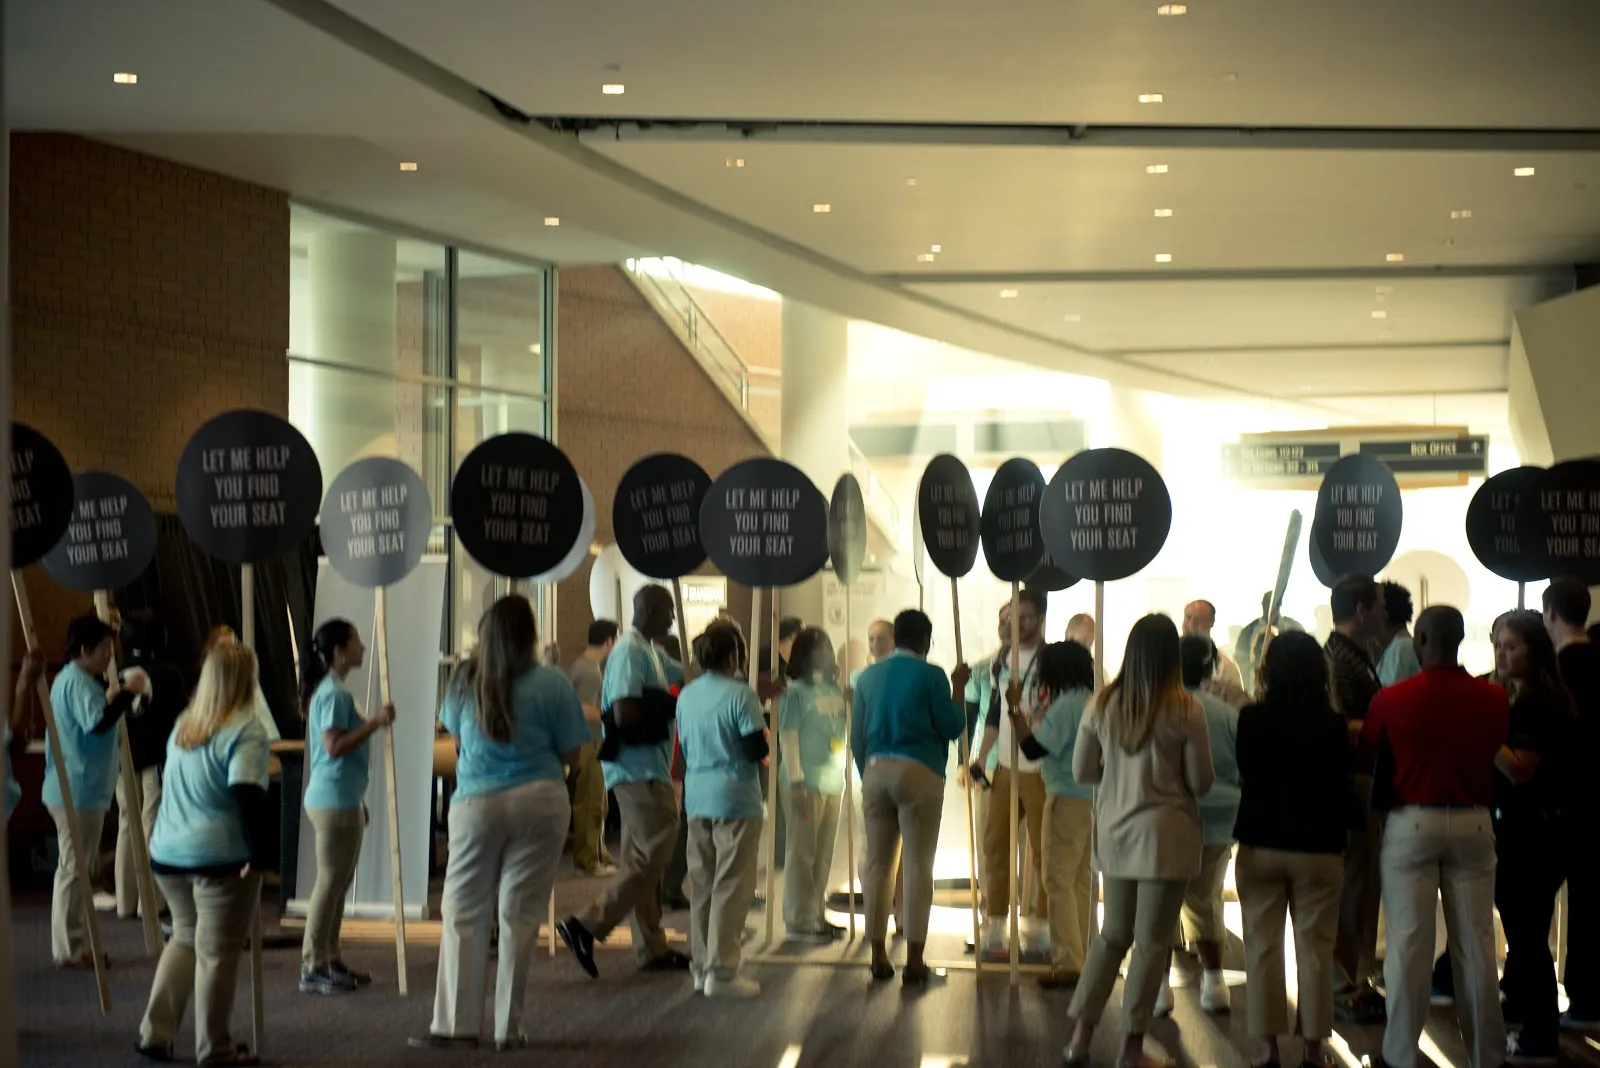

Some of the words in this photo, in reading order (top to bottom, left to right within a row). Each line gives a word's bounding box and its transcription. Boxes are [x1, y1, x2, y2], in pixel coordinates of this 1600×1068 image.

[202, 448, 225, 472] LET
[230, 447, 250, 471] ME
[256, 445, 290, 470] HELP
[214, 475, 242, 500] YOU
[248, 473, 279, 499] FIND
[481, 463, 502, 488] LET
[508, 467, 525, 490] ME
[530, 468, 560, 493] HELP
[1065, 480, 1084, 502] LET
[1090, 479, 1107, 501] ME
[1112, 478, 1142, 500] HELP
[79, 499, 96, 520] ME
[100, 494, 127, 516] HELP
[340, 490, 357, 513] LET
[362, 487, 377, 510] ME
[381, 484, 407, 507] HELP
[490, 492, 516, 516] YOU
[520, 494, 547, 519] FIND
[630, 487, 647, 512] LET
[651, 484, 667, 504] ME
[671, 479, 695, 502] HELP
[726, 488, 745, 509] LET
[750, 488, 767, 509] ME
[772, 488, 800, 510] HELP
[1331, 484, 1344, 505] LET
[1346, 484, 1358, 504] ME
[1361, 484, 1383, 504] HELP
[1491, 491, 1509, 511] LET
[1541, 489, 1561, 511] LET
[1566, 490, 1585, 511] ME
[209, 502, 247, 528] YOUR
[252, 500, 286, 526] SEAT
[350, 513, 371, 535] YOU
[375, 509, 400, 531] FIND
[641, 508, 663, 530] YOU
[666, 502, 690, 527] FIND
[735, 511, 758, 533] YOU
[762, 511, 789, 533] FIND
[1075, 503, 1099, 525] YOU
[1104, 502, 1132, 525] FIND
[1336, 507, 1353, 528] YOU
[1355, 507, 1375, 528] FIND
[1551, 513, 1576, 534] YOU
[1581, 513, 1600, 535] FIN
[68, 521, 91, 543] YOU
[95, 518, 121, 539] FIND
[484, 516, 517, 542] YOUR
[522, 520, 551, 544] SEAT
[641, 530, 669, 554] YOUR
[672, 524, 697, 548] SEAT
[1070, 528, 1102, 551] YOUR
[1107, 526, 1138, 549] SEAT
[1333, 530, 1354, 551] YOUR
[1357, 530, 1378, 552] SEAT
[66, 542, 98, 566] YOUR
[101, 539, 129, 560] SEAT
[347, 536, 375, 559] YOUR
[378, 531, 405, 554] SEAT
[729, 535, 760, 556] YOUR
[765, 535, 794, 556] SEAT
[1546, 535, 1579, 557] YOUR
[1584, 535, 1600, 558] SE
